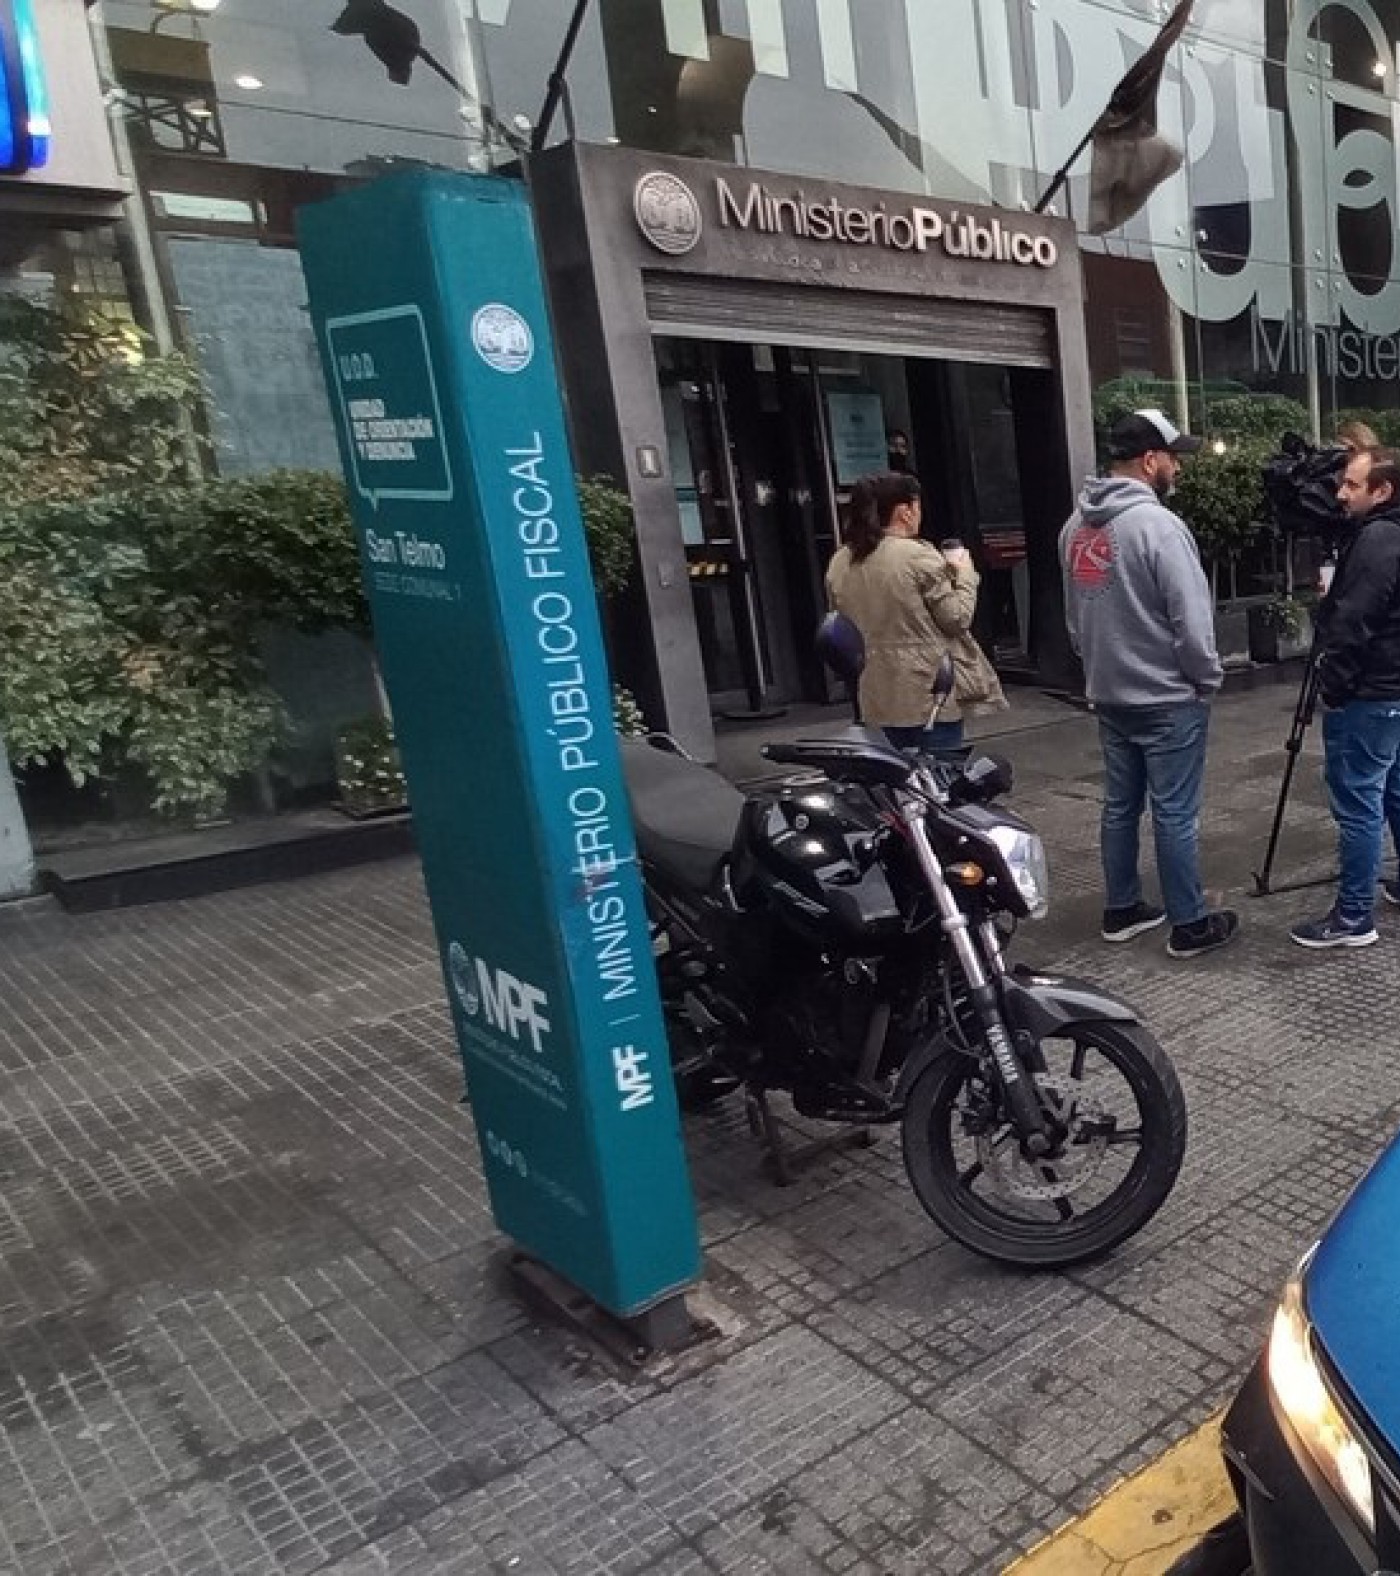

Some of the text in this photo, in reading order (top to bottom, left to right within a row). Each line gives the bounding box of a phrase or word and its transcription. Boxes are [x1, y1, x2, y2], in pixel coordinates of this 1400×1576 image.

[715, 177, 1057, 268] MinisterioPúblico
[366, 528, 446, 570] San Telmo
[504, 431, 655, 1111] MPF MINISTERIO PÚBLICO FISCAL
[475, 957, 552, 1053] MPF
